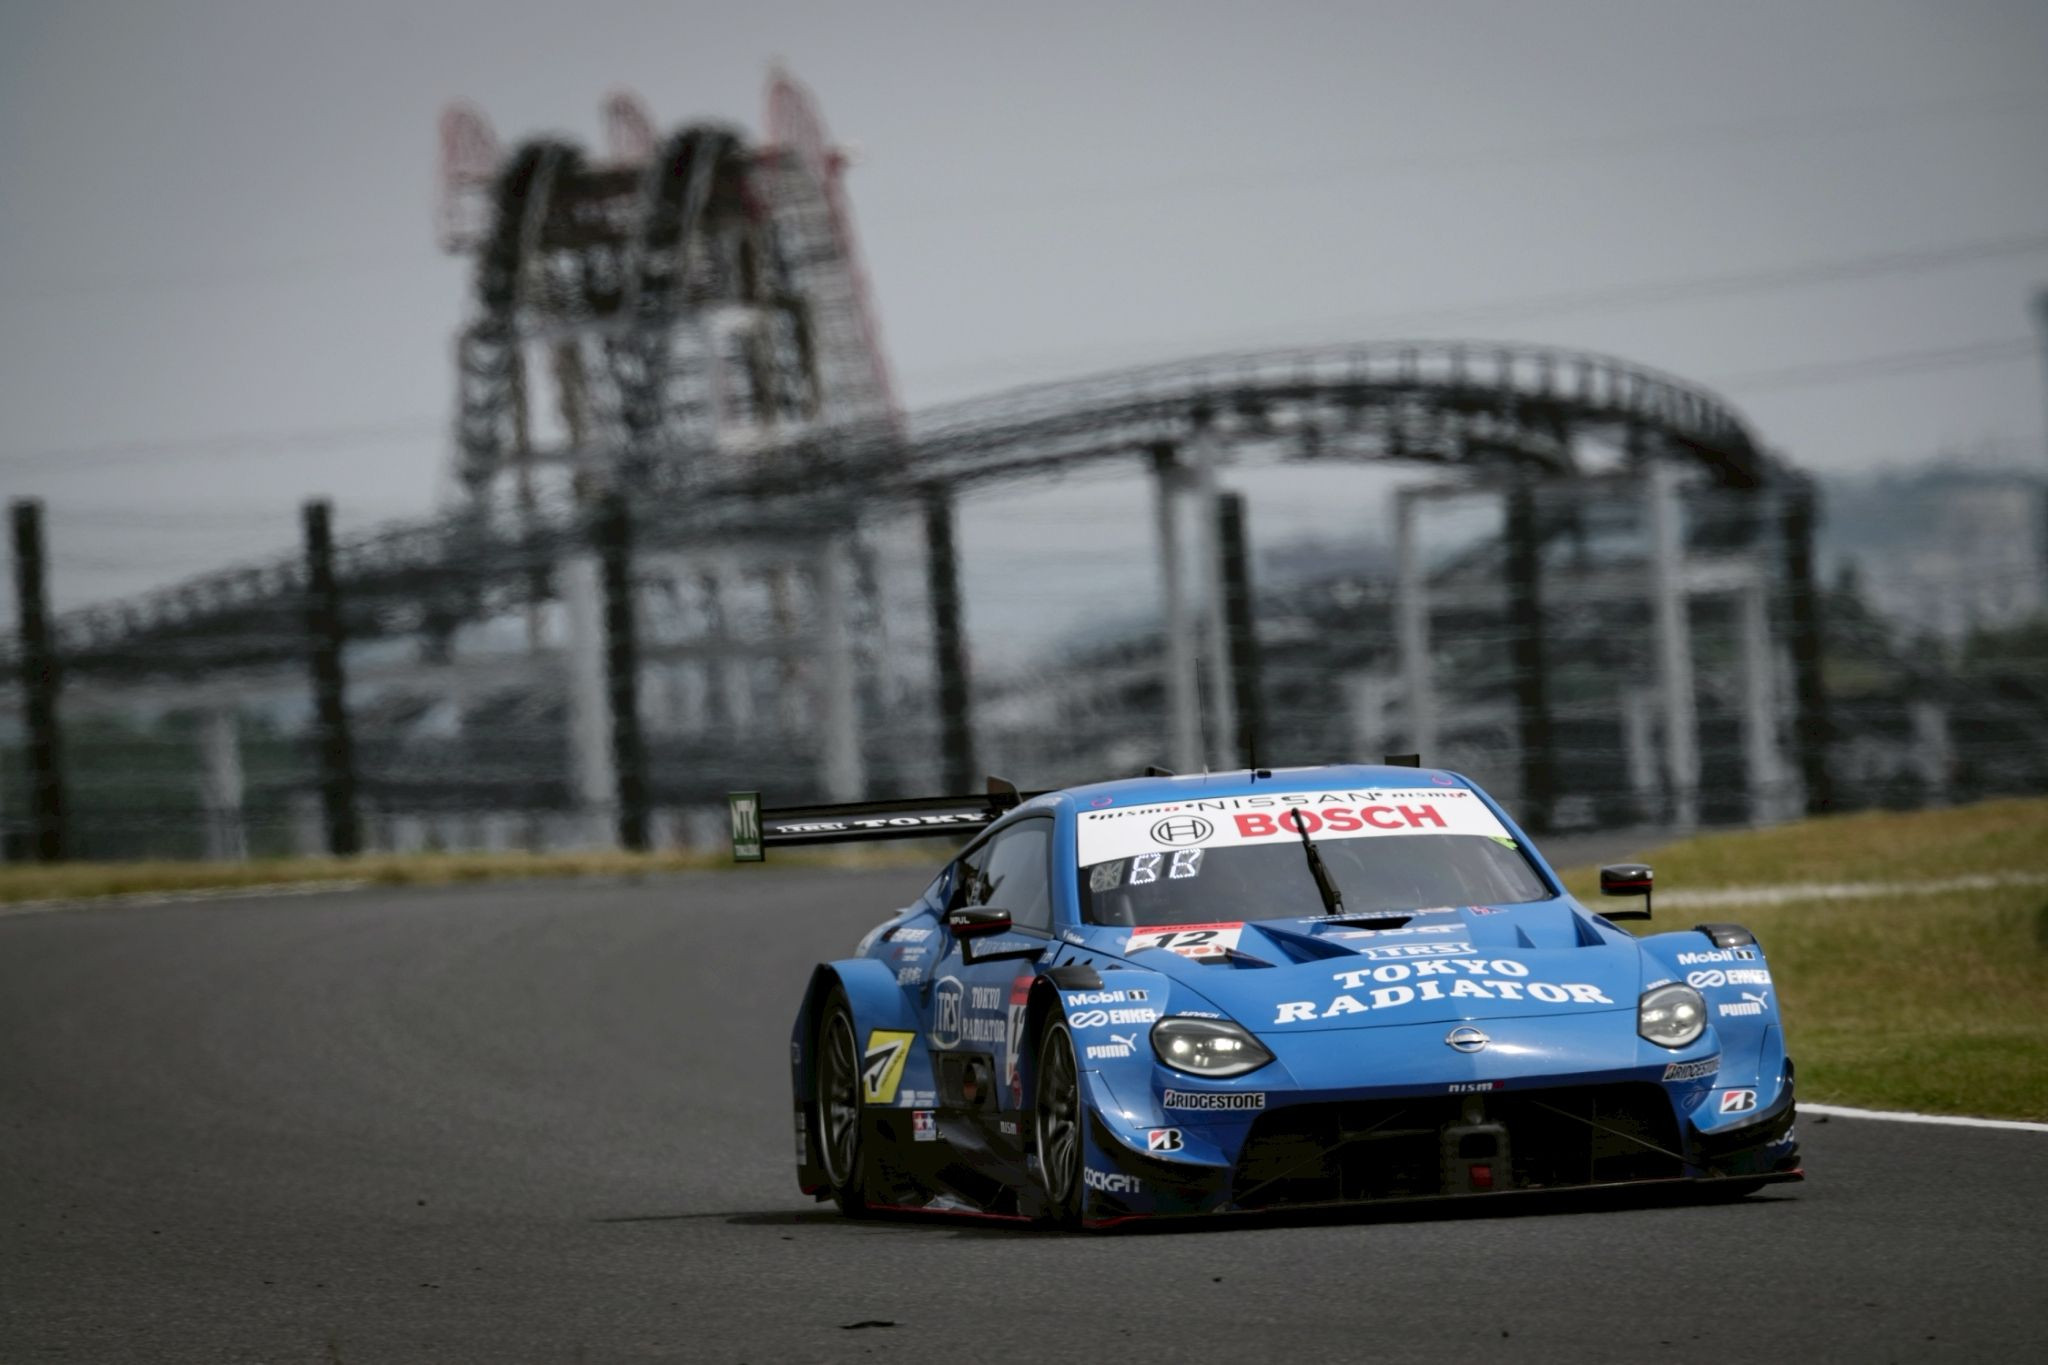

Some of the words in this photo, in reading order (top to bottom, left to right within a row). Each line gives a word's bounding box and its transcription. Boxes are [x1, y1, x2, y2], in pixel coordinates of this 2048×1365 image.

[1198, 791, 1377, 812] NISSAN
[730, 799, 759, 840] NTK
[854, 811, 998, 828] TOKY
[1233, 804, 1449, 838] BOSCH
[1154, 930, 1219, 949] 12
[1676, 948, 1733, 966] Mobil
[1333, 959, 1529, 990] TOKYO
[971, 986, 1001, 1010] TOKYO
[1067, 990, 1127, 1007] Mobil
[1273, 979, 1615, 1025] RADIATOR
[937, 991, 959, 1032] TRS
[1719, 1002, 1762, 1017] PUMA
[962, 1019, 1006, 1042] RADIATOR
[1086, 1045, 1130, 1060] PUMA
[1448, 1080, 1505, 1093] nismo
[1164, 1089, 1265, 1110] BRIDGESTONE
[1084, 1166, 1142, 1194] COCKPIT
